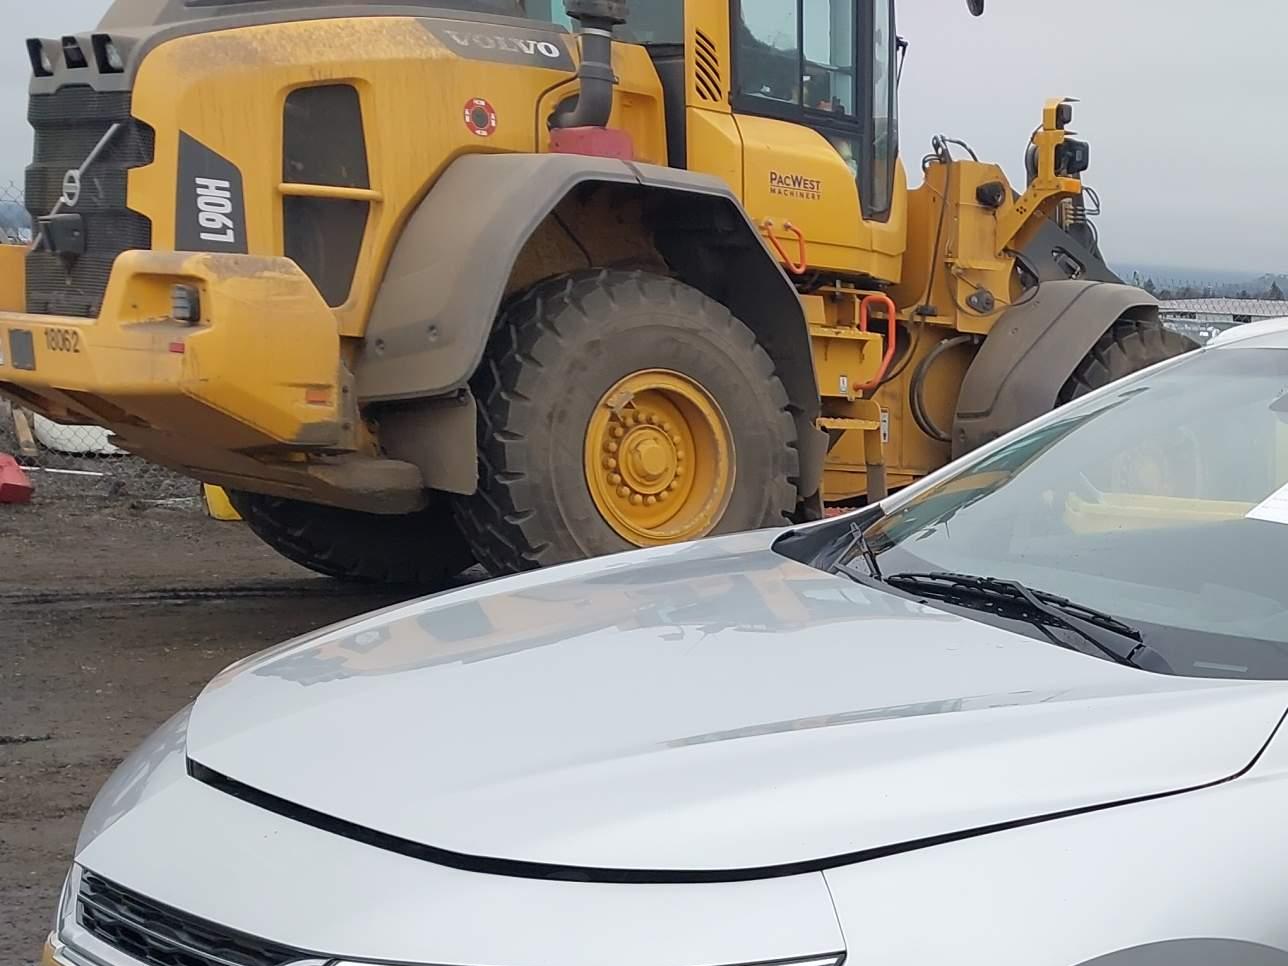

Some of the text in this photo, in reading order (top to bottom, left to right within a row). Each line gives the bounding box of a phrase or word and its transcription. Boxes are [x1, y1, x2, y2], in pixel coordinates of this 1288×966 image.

[443, 29, 560, 58] VOLVO
[194, 176, 235, 243] L90H
[44, 327, 80, 354] 18062
